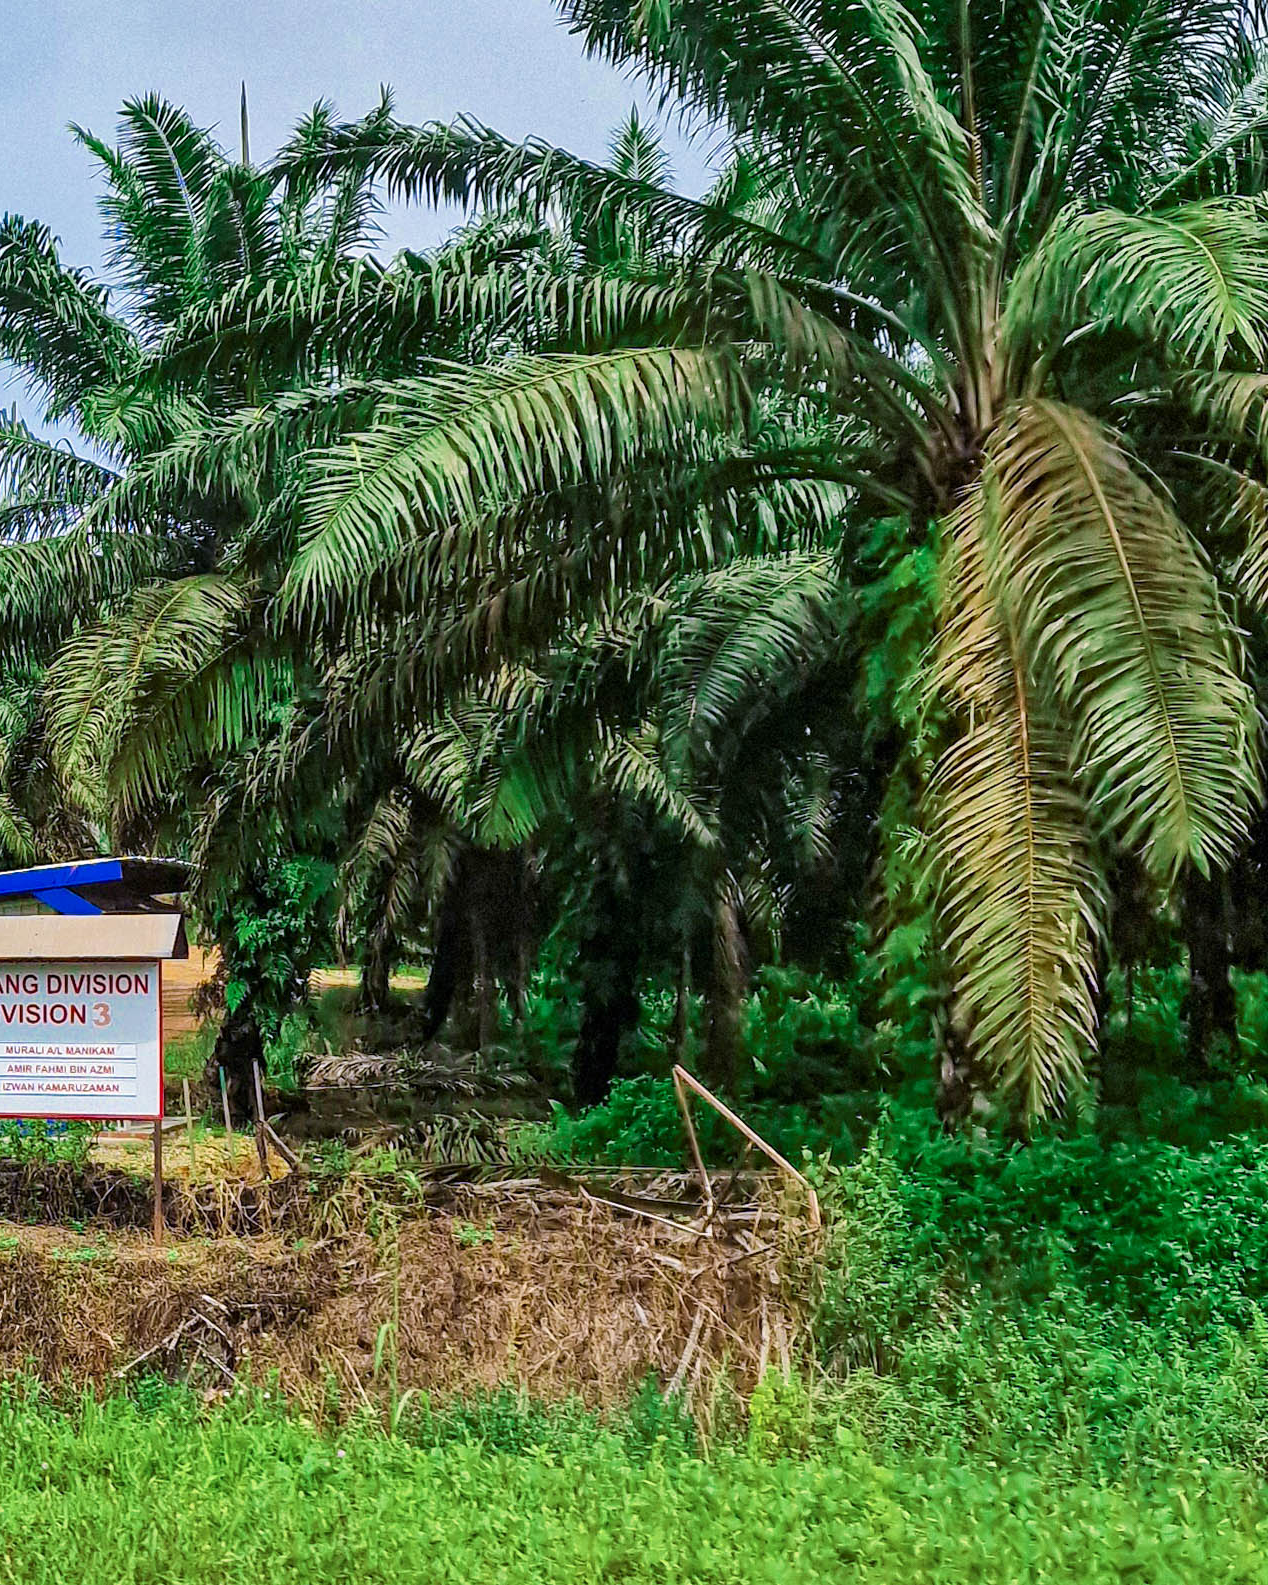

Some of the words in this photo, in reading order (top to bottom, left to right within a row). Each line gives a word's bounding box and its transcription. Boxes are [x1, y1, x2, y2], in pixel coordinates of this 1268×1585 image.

[47, 974, 149, 994] DIVISION
[92, 1003, 111, 1026] 3
[5, 1045, 44, 1055] MURALI
[46, 1045, 63, 1055] A/L
[65, 1046, 115, 1056] MANIKAM
[7, 1064, 32, 1074] AMIR
[35, 1064, 67, 1074] FAHMI
[69, 1065, 87, 1074] BIN
[90, 1065, 115, 1075] AZMI
[2, 1082, 34, 1092] IZWAN
[37, 1082, 120, 1093] KAMARUZAMAN
